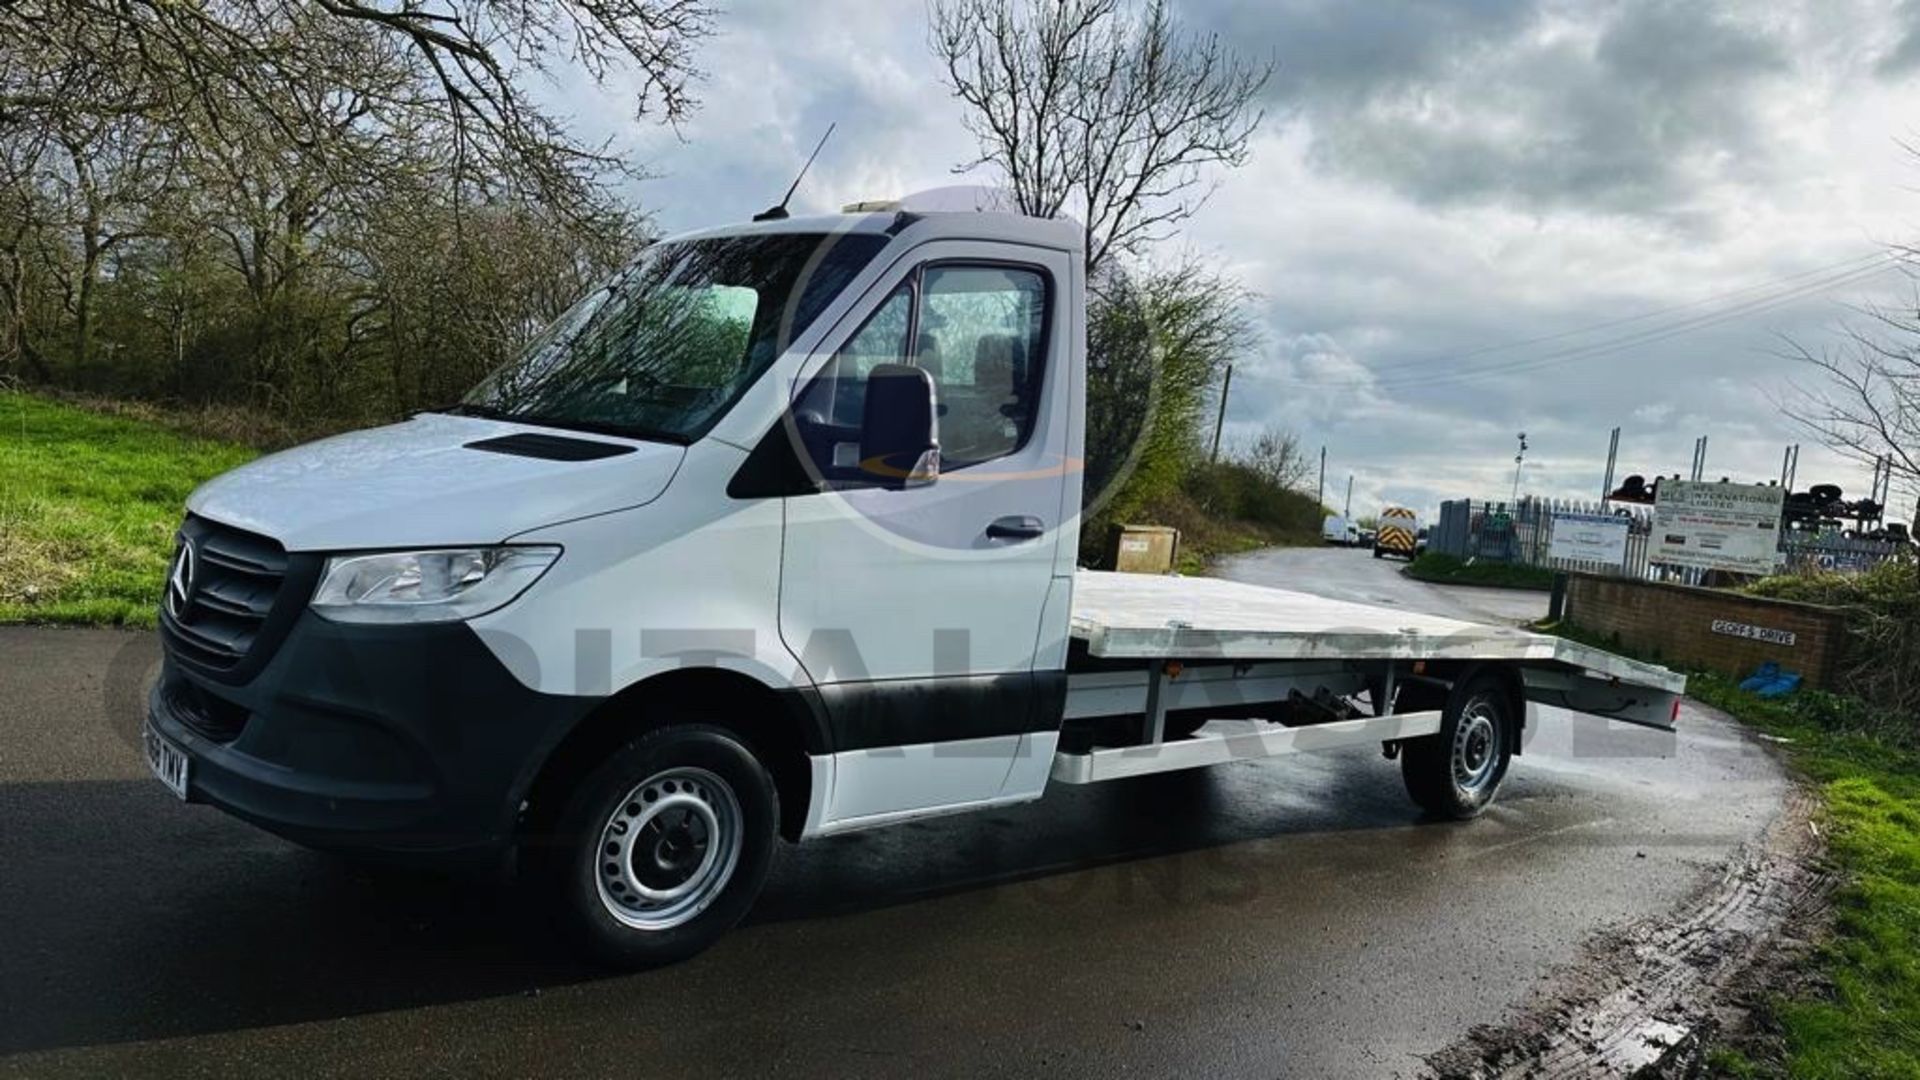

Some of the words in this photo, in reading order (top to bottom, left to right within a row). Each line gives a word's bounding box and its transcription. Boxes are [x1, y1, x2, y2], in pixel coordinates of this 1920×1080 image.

[1690, 500, 1735, 510] LIMITED
[1691, 492, 1780, 505] INTERNATIONAL
[1760, 628, 1792, 643] DRIVE
